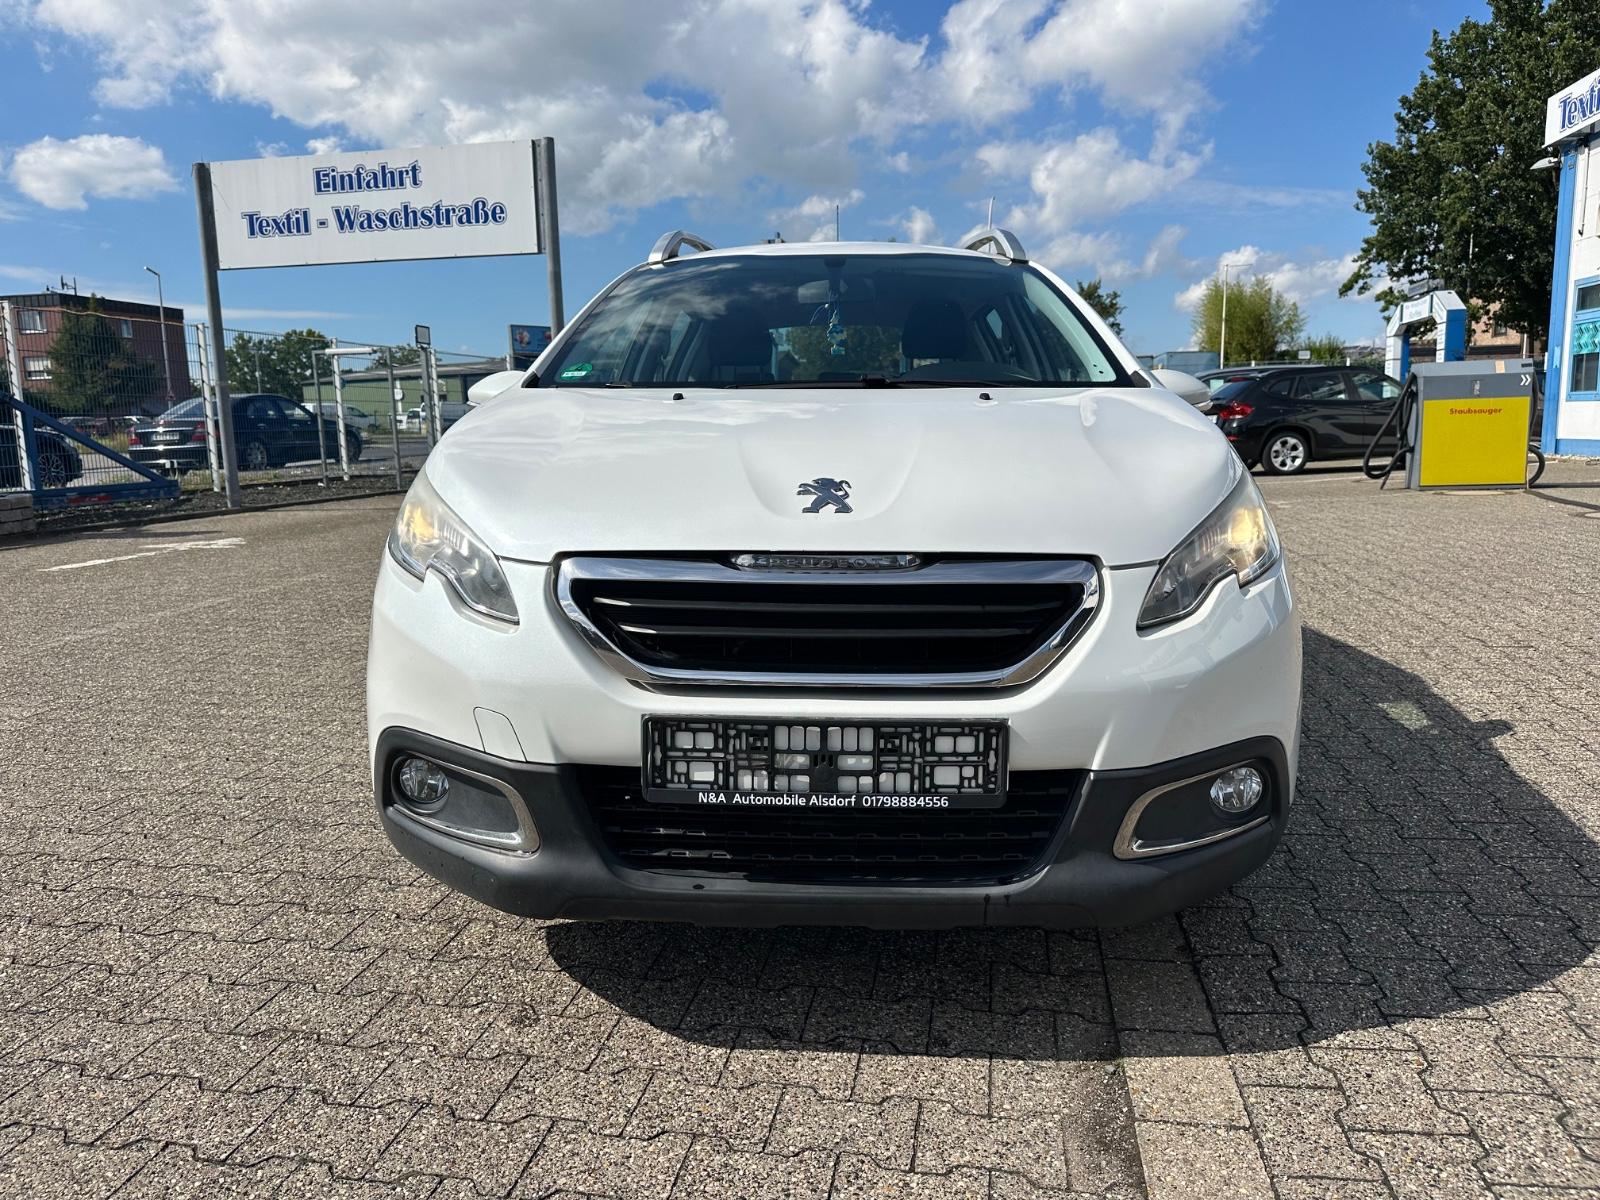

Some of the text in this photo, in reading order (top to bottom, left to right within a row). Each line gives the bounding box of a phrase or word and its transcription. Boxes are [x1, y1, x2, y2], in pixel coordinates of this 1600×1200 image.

[313, 161, 422, 194] Einfahrt
[243, 208, 311, 237] Textil
[332, 197, 507, 233] Waschstraße
[1449, 407, 1503, 416] Staubsauger
[769, 557, 882, 568] PEUGEOT
[698, 792, 949, 807] N&A Automobile Alsdorf 01798884556
